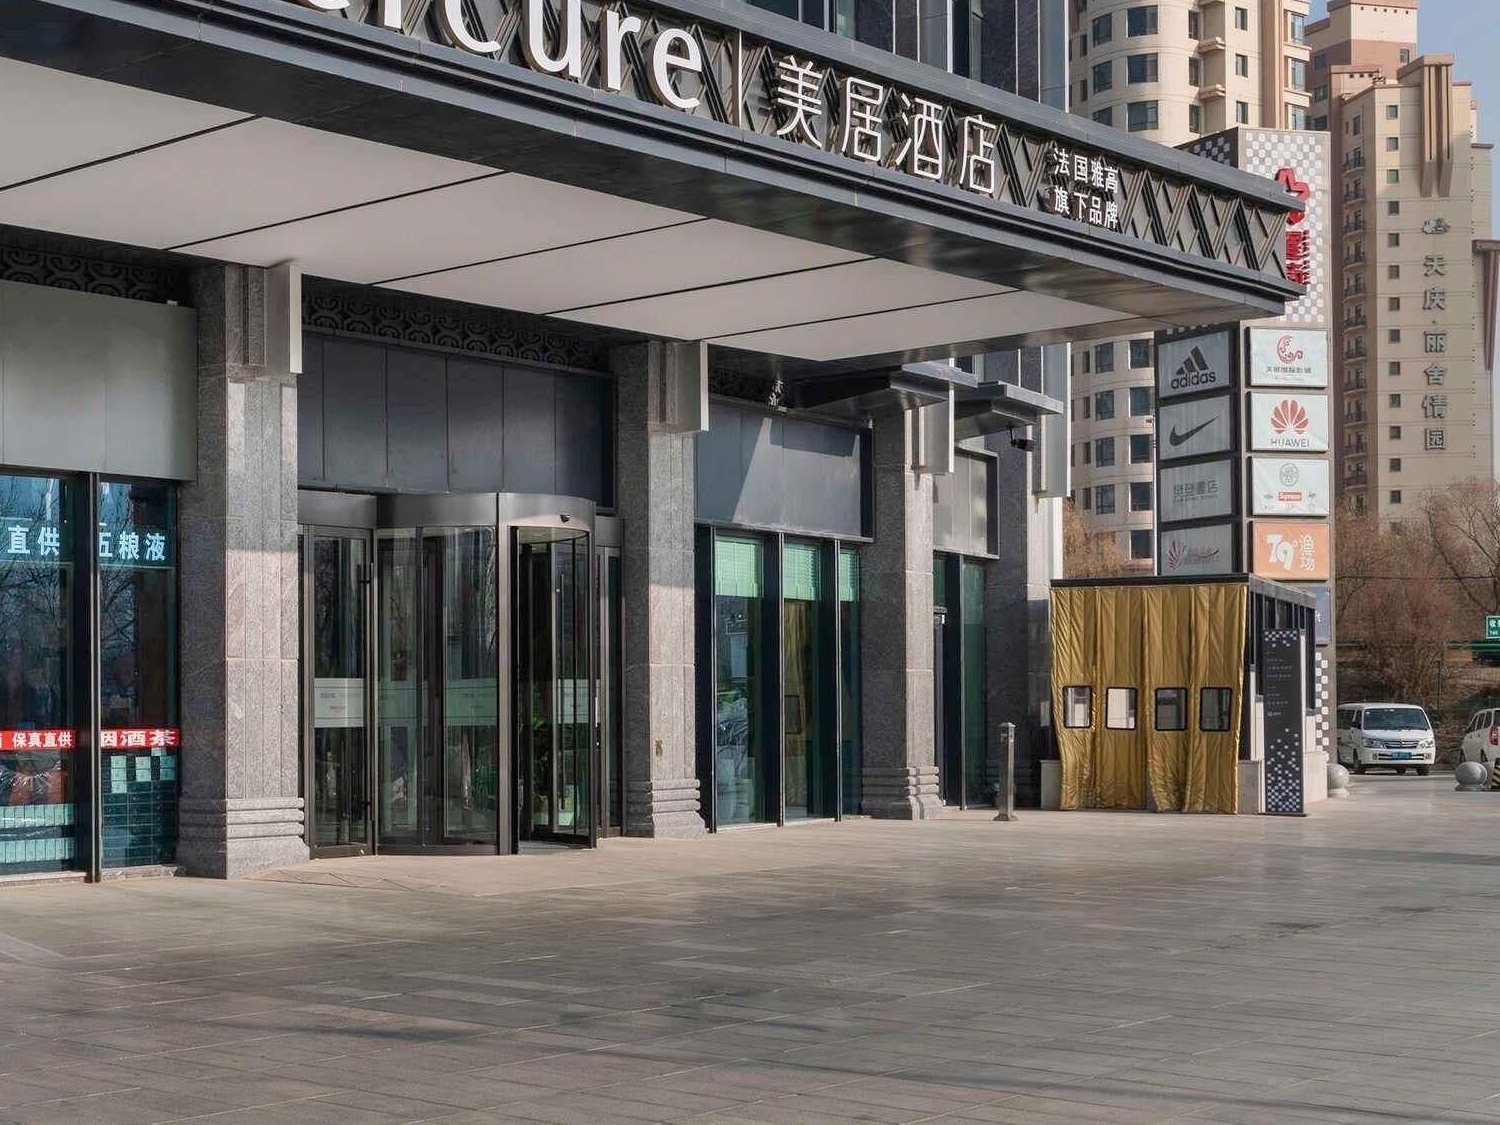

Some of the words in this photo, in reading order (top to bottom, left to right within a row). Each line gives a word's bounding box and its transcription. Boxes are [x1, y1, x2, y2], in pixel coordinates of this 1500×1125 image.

[777, 55, 996, 193] 美居酒店
[1053, 148, 1118, 193] 法国雅高
[1054, 185, 1118, 228] 旗下品牌
[1171, 371, 1216, 389] adidas
[1271, 438, 1309, 447] HUAWEI
[99, 531, 166, 561] 五粮液
[12, 731, 72, 748] 保真直供
